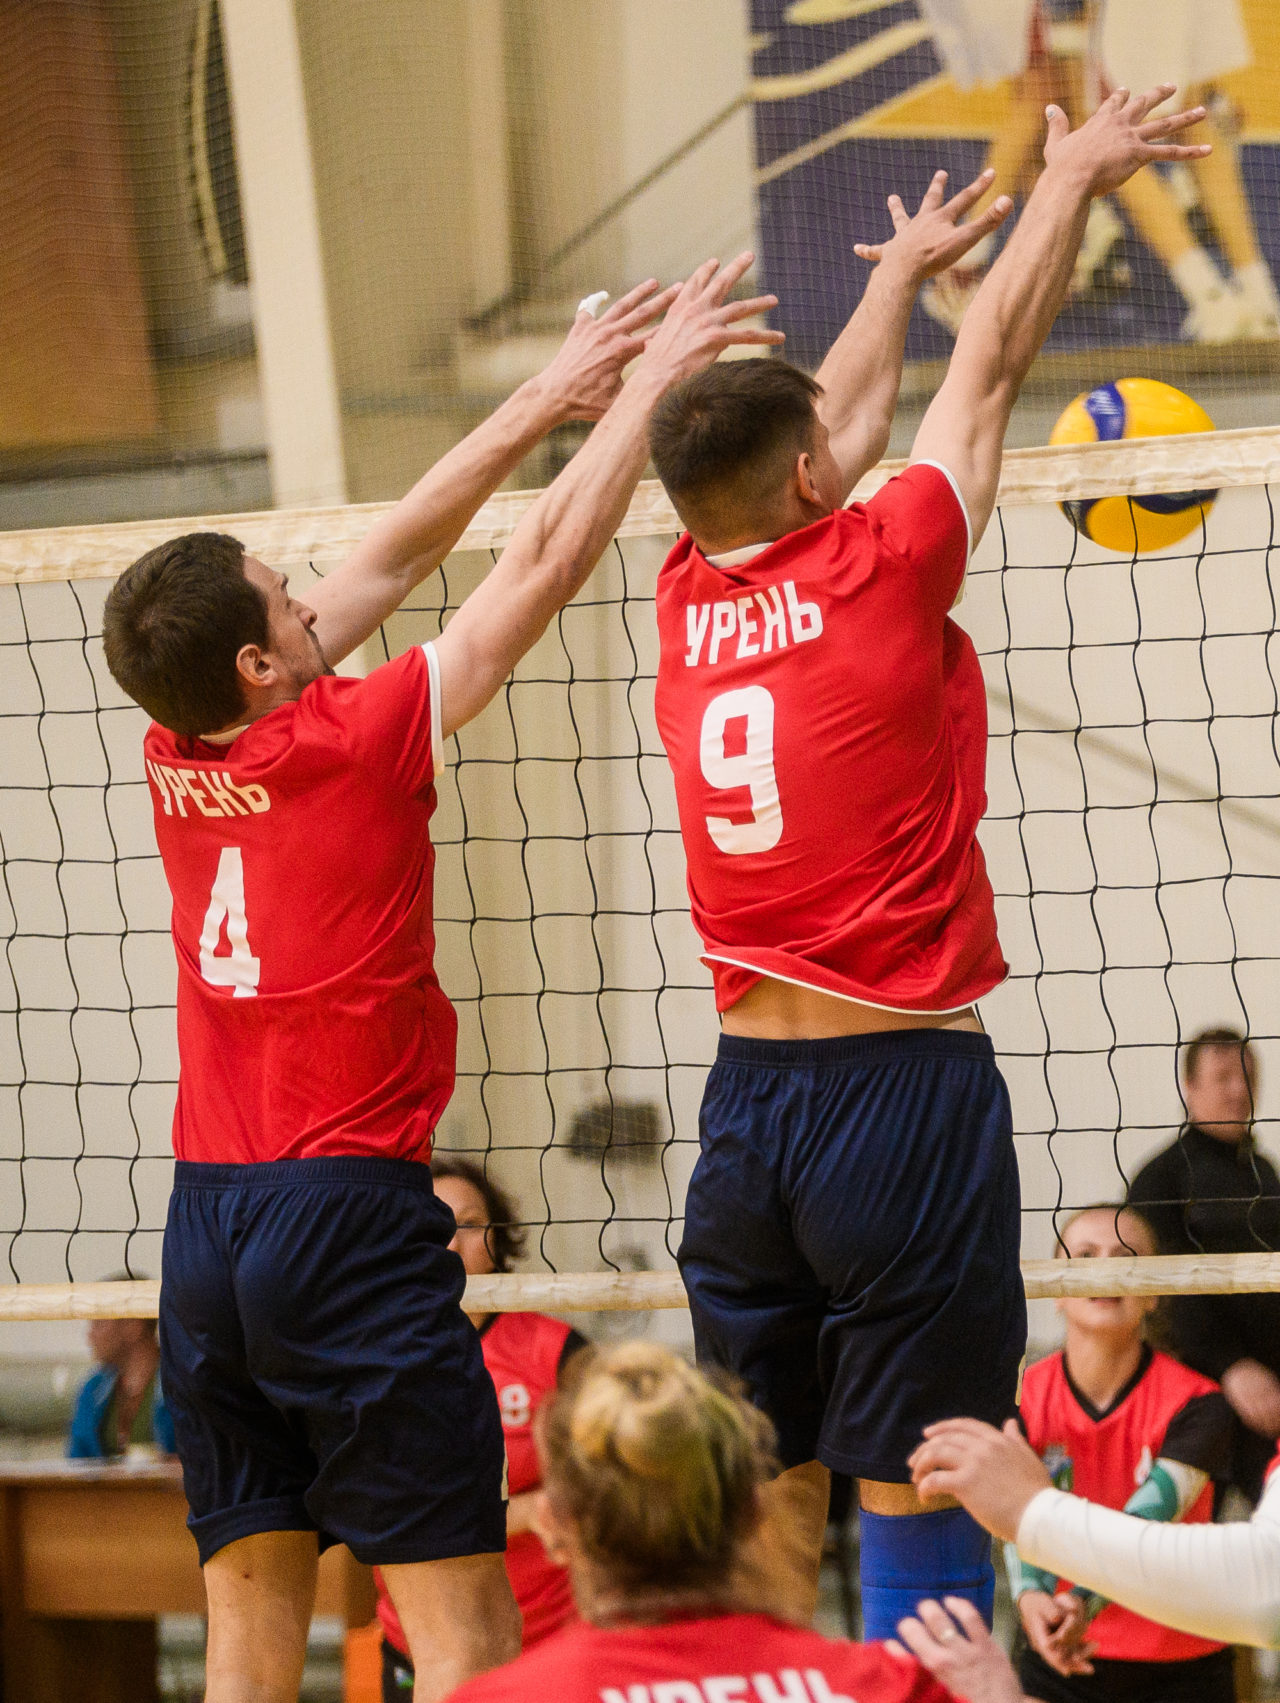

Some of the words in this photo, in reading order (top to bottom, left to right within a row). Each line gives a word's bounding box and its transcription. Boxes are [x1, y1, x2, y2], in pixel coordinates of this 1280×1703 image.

[685, 581, 823, 666] УРЕНЬ
[146, 758, 271, 817] УРЕНЬ
[700, 685, 783, 855] 9
[199, 847, 260, 998] 4
